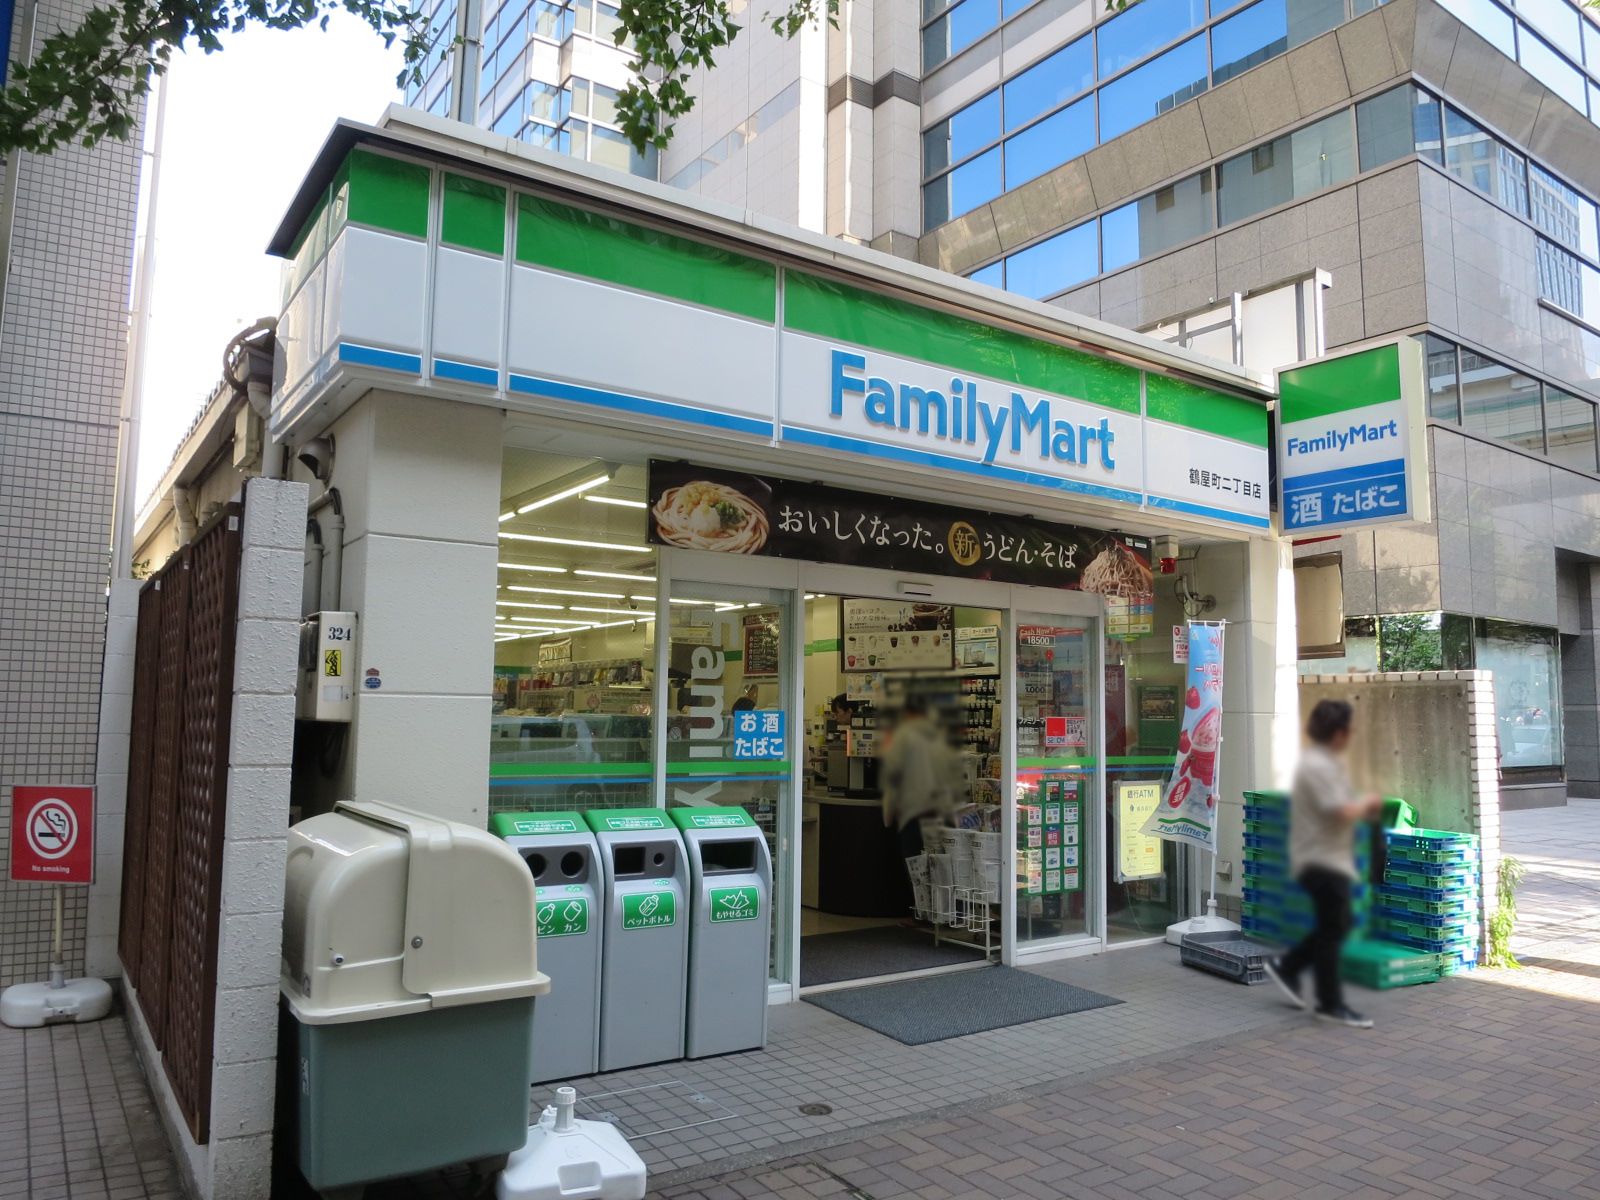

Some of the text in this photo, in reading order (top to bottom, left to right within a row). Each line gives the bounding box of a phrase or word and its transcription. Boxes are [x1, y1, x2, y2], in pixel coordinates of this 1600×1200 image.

[829, 348, 1116, 472] FamilyMart
[1287, 419, 1398, 457] FamilyMart
[1189, 467, 1262, 499] 鶴屋町二丁目店
[1291, 484, 1400, 525] 酒 たばこ
[779, 505, 1078, 570] おいしくなった。 新 うどん・そば
[328, 627, 351, 641] 324
[1027, 635, 1050, 645] 18500
[740, 713, 779, 734] お酒
[735, 737, 784, 757] たばこ
[1127, 789, 1154, 799] 銀行ATM
[43, 865, 70, 874] smoking
[627, 913, 671, 926] ペットボトル
[715, 908, 755, 920] もやせるゴミ
[537, 921, 583, 935] ビン カン
